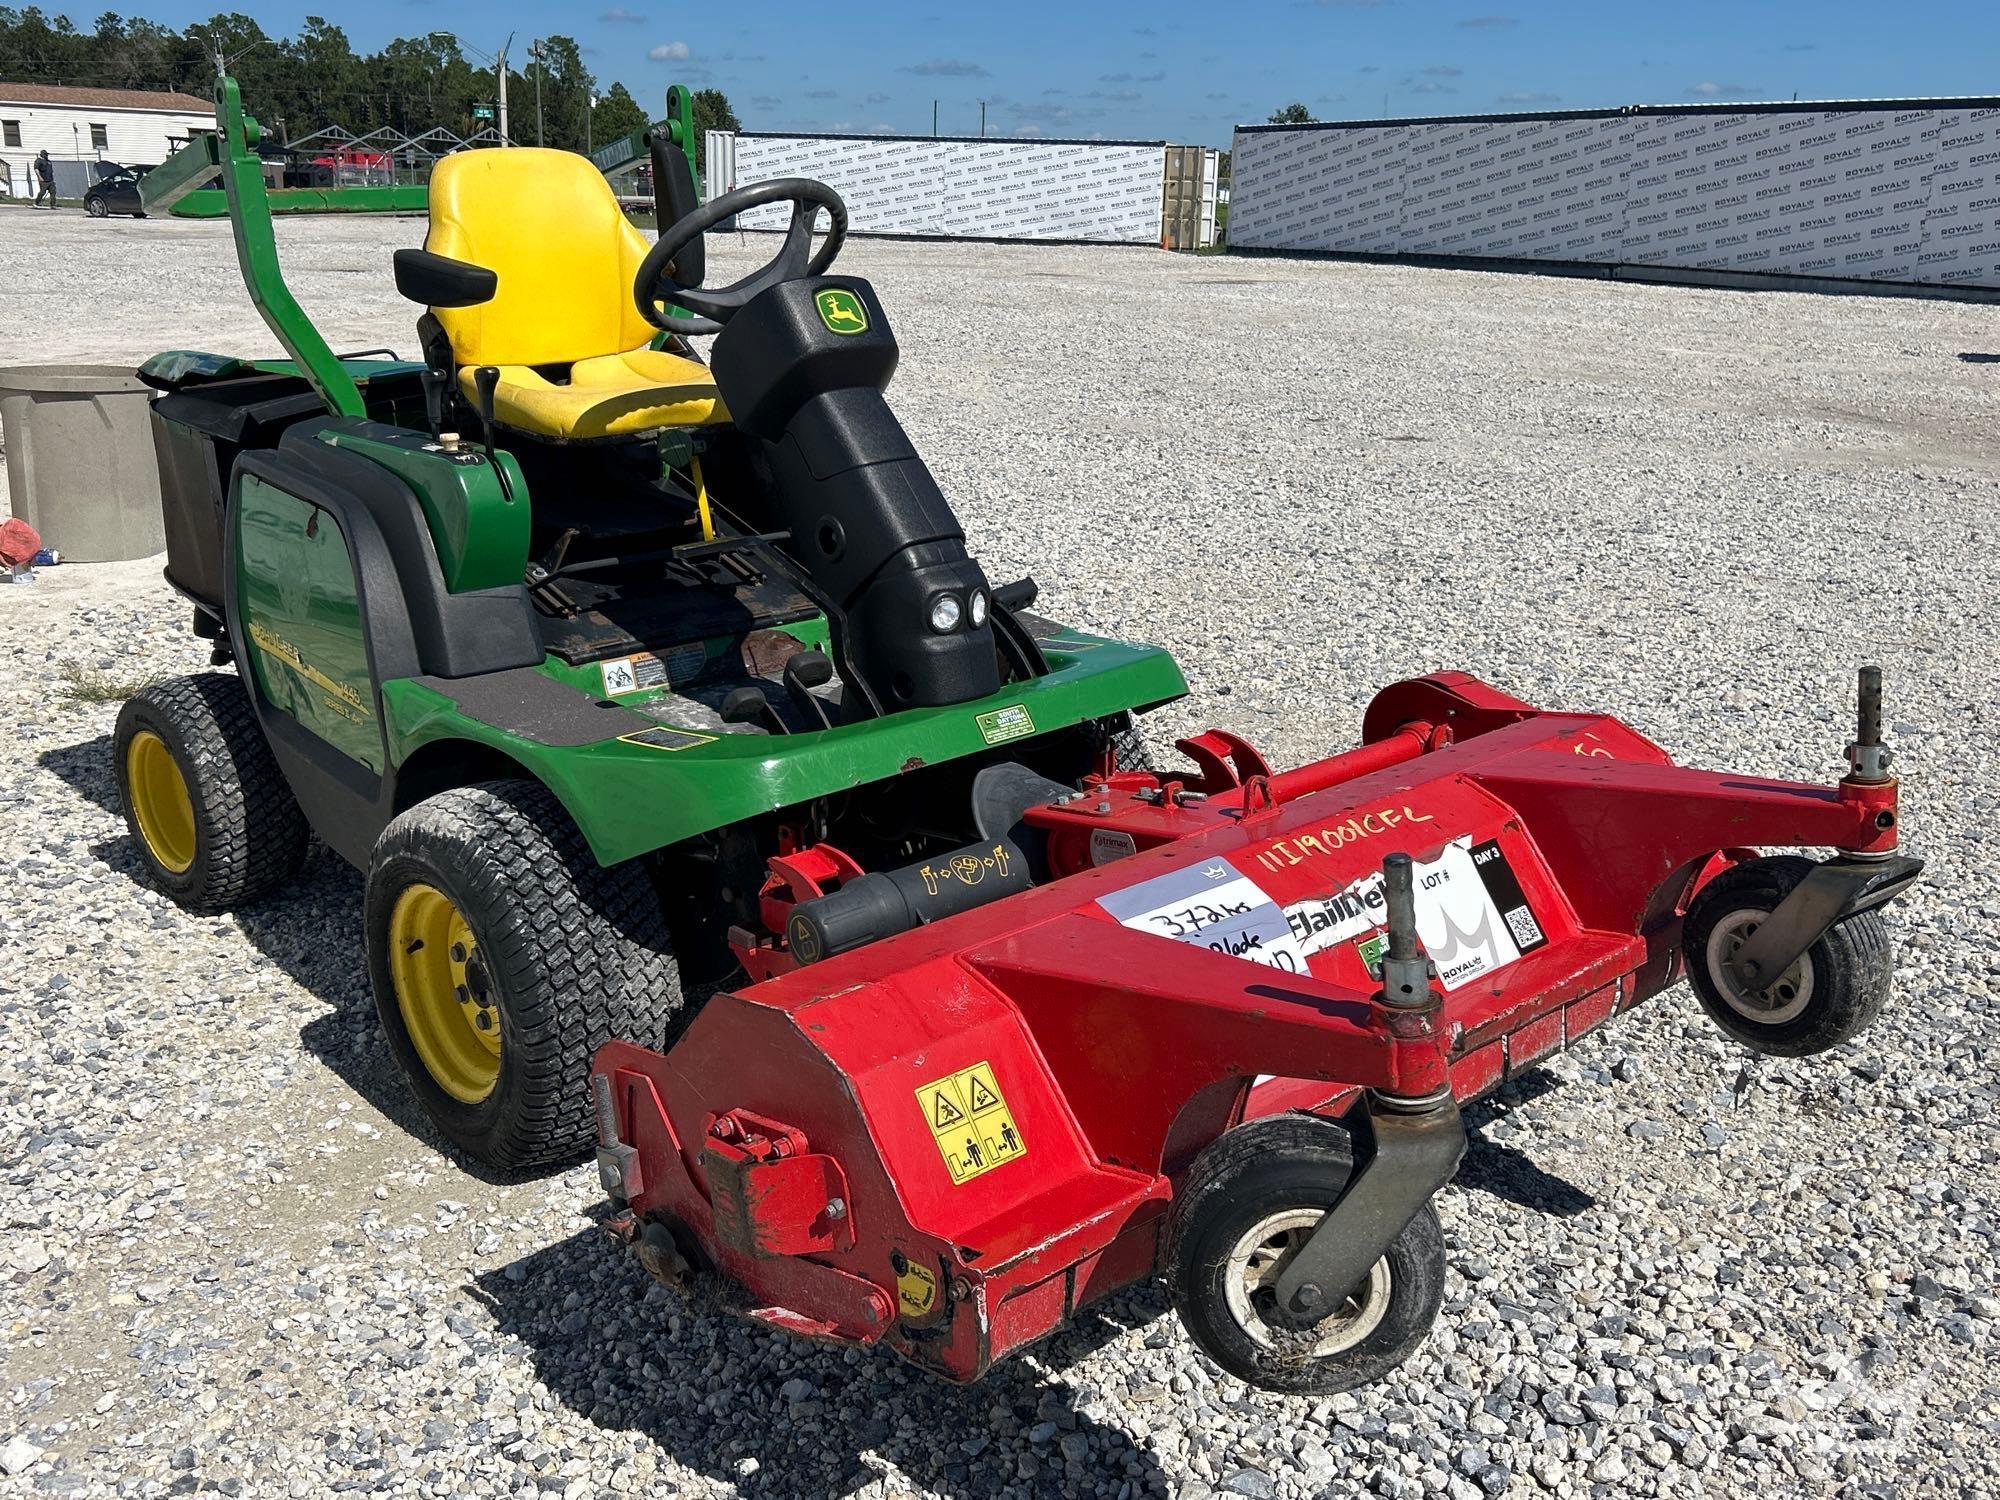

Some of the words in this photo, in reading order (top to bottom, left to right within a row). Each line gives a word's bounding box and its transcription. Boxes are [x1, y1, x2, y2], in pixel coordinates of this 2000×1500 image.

[1714, 116, 1739, 128] ROYAL
[1894, 111, 1925, 123] ROYAL
[1779, 118, 1806, 130] ROYAL
[1846, 121, 1875, 134] ROYAL
[1565, 127, 1587, 139] ROYAL
[1674, 126, 1699, 138] ROYAL
[1736, 129, 1762, 141] ROYAL
[1486, 135, 1505, 145] ROYAL
[1532, 138, 1553, 149] ROYAL
[1637, 137, 1660, 148] ROYAL
[1800, 133, 1828, 146] ROYAL
[1871, 137, 1902, 149] ROYAL
[1942, 135, 1975, 147] ROYAL
[1456, 144, 1474, 155] ROYAL
[1584, 140, 1606, 151] ROYAL
[1695, 140, 1720, 152] ROYAL
[1756, 145, 1783, 156] ROYAL
[1501, 148, 1520, 158] ROYAL
[1550, 150, 1571, 161] ROYAL
[1657, 150, 1680, 161] ROYAL
[1824, 148, 1853, 160] ROYAL
[1470, 157, 1489, 167] ROYAL
[1517, 160, 1537, 170] ROYAL
[1714, 155, 1740, 167] ROYAL
[1779, 159, 1806, 171] ROYAL
[1894, 153, 1925, 166] ROYAL
[1487, 169, 1506, 179] ROYAL
[1566, 164, 1588, 174] ROYAL
[1675, 165, 1699, 176] ROYAL
[1845, 164, 1875, 176] ROYAL
[1533, 173, 1553, 184] ROYAL
[1637, 175, 1660, 185] ROYAL
[1736, 170, 1762, 181] ROYAL
[1800, 175, 1828, 187] ROYAL
[1457, 178, 1475, 188] ROYAL
[1501, 182, 1521, 192] ROYAL
[1584, 177, 1606, 187] ROYAL
[1696, 180, 1721, 190] ROYAL
[1871, 180, 1901, 192] ROYAL
[1942, 180, 1974, 191] ROYAL
[1471, 191, 1490, 201] ROYAL
[1551, 186, 1572, 196] ROYAL
[1657, 189, 1681, 199] ROYAL
[1756, 185, 1783, 196] ROYAL
[1518, 195, 1538, 205] ROYAL
[1715, 195, 1740, 206] ROYAL
[1824, 191, 1852, 202] ROYAL
[1442, 200, 1460, 209] ROYAL
[1487, 204, 1506, 213] ROYAL
[1567, 200, 1588, 210] ROYAL
[1779, 200, 1806, 211] ROYAL
[1893, 197, 1925, 209] ROYAL
[1534, 209, 1554, 218] ROYAL
[1675, 204, 1699, 214] ROYAL
[1845, 207, 1875, 218] ROYAL
[1457, 212, 1476, 221] ROYAL
[1585, 213, 1607, 223] ROYAL
[1637, 212, 1661, 222] ROYAL
[1736, 210, 1762, 220] ROYAL
[1502, 217, 1521, 227] ROYAL
[1551, 222, 1572, 232] ROYAL
[1696, 219, 1721, 229] ROYAL
[1799, 217, 1827, 227] ROYAL
[1472, 225, 1490, 234] ROYAL
[1519, 230, 1539, 239] ROYAL
[1658, 227, 1681, 237] ROYAL
[1756, 226, 1783, 236] ROYAL
[1870, 223, 1901, 235] ROYAL
[1941, 224, 1974, 235] ROYAL
[1567, 236, 1588, 245] ROYAL
[1715, 234, 1740, 244] ROYAL
[1824, 233, 1852, 243] ROYAL
[1676, 242, 1700, 252] ROYAL
[1779, 241, 1806, 252] ROYAL
[1638, 250, 1661, 259] ROYAL
[1737, 250, 1763, 260] ROYAL
[1845, 249, 1875, 260] ROYAL
[1918, 251, 1949, 261] ROYAL
[1697, 258, 1722, 268] ROYAL
[1799, 258, 1827, 268] ROYAL
[1870, 266, 1900, 277] ROYAL
[1941, 269, 1974, 279] ROYAL
[1103, 836, 1129, 848] trimax
[1474, 849, 1493, 865] DAY
[1492, 847, 1501, 858] 3
[1420, 872, 1442, 891] LOT
[1442, 960, 1475, 980] ROYAL
[1447, 973, 1470, 986] AUCTION
[1468, 964, 1486, 977] GROUP
